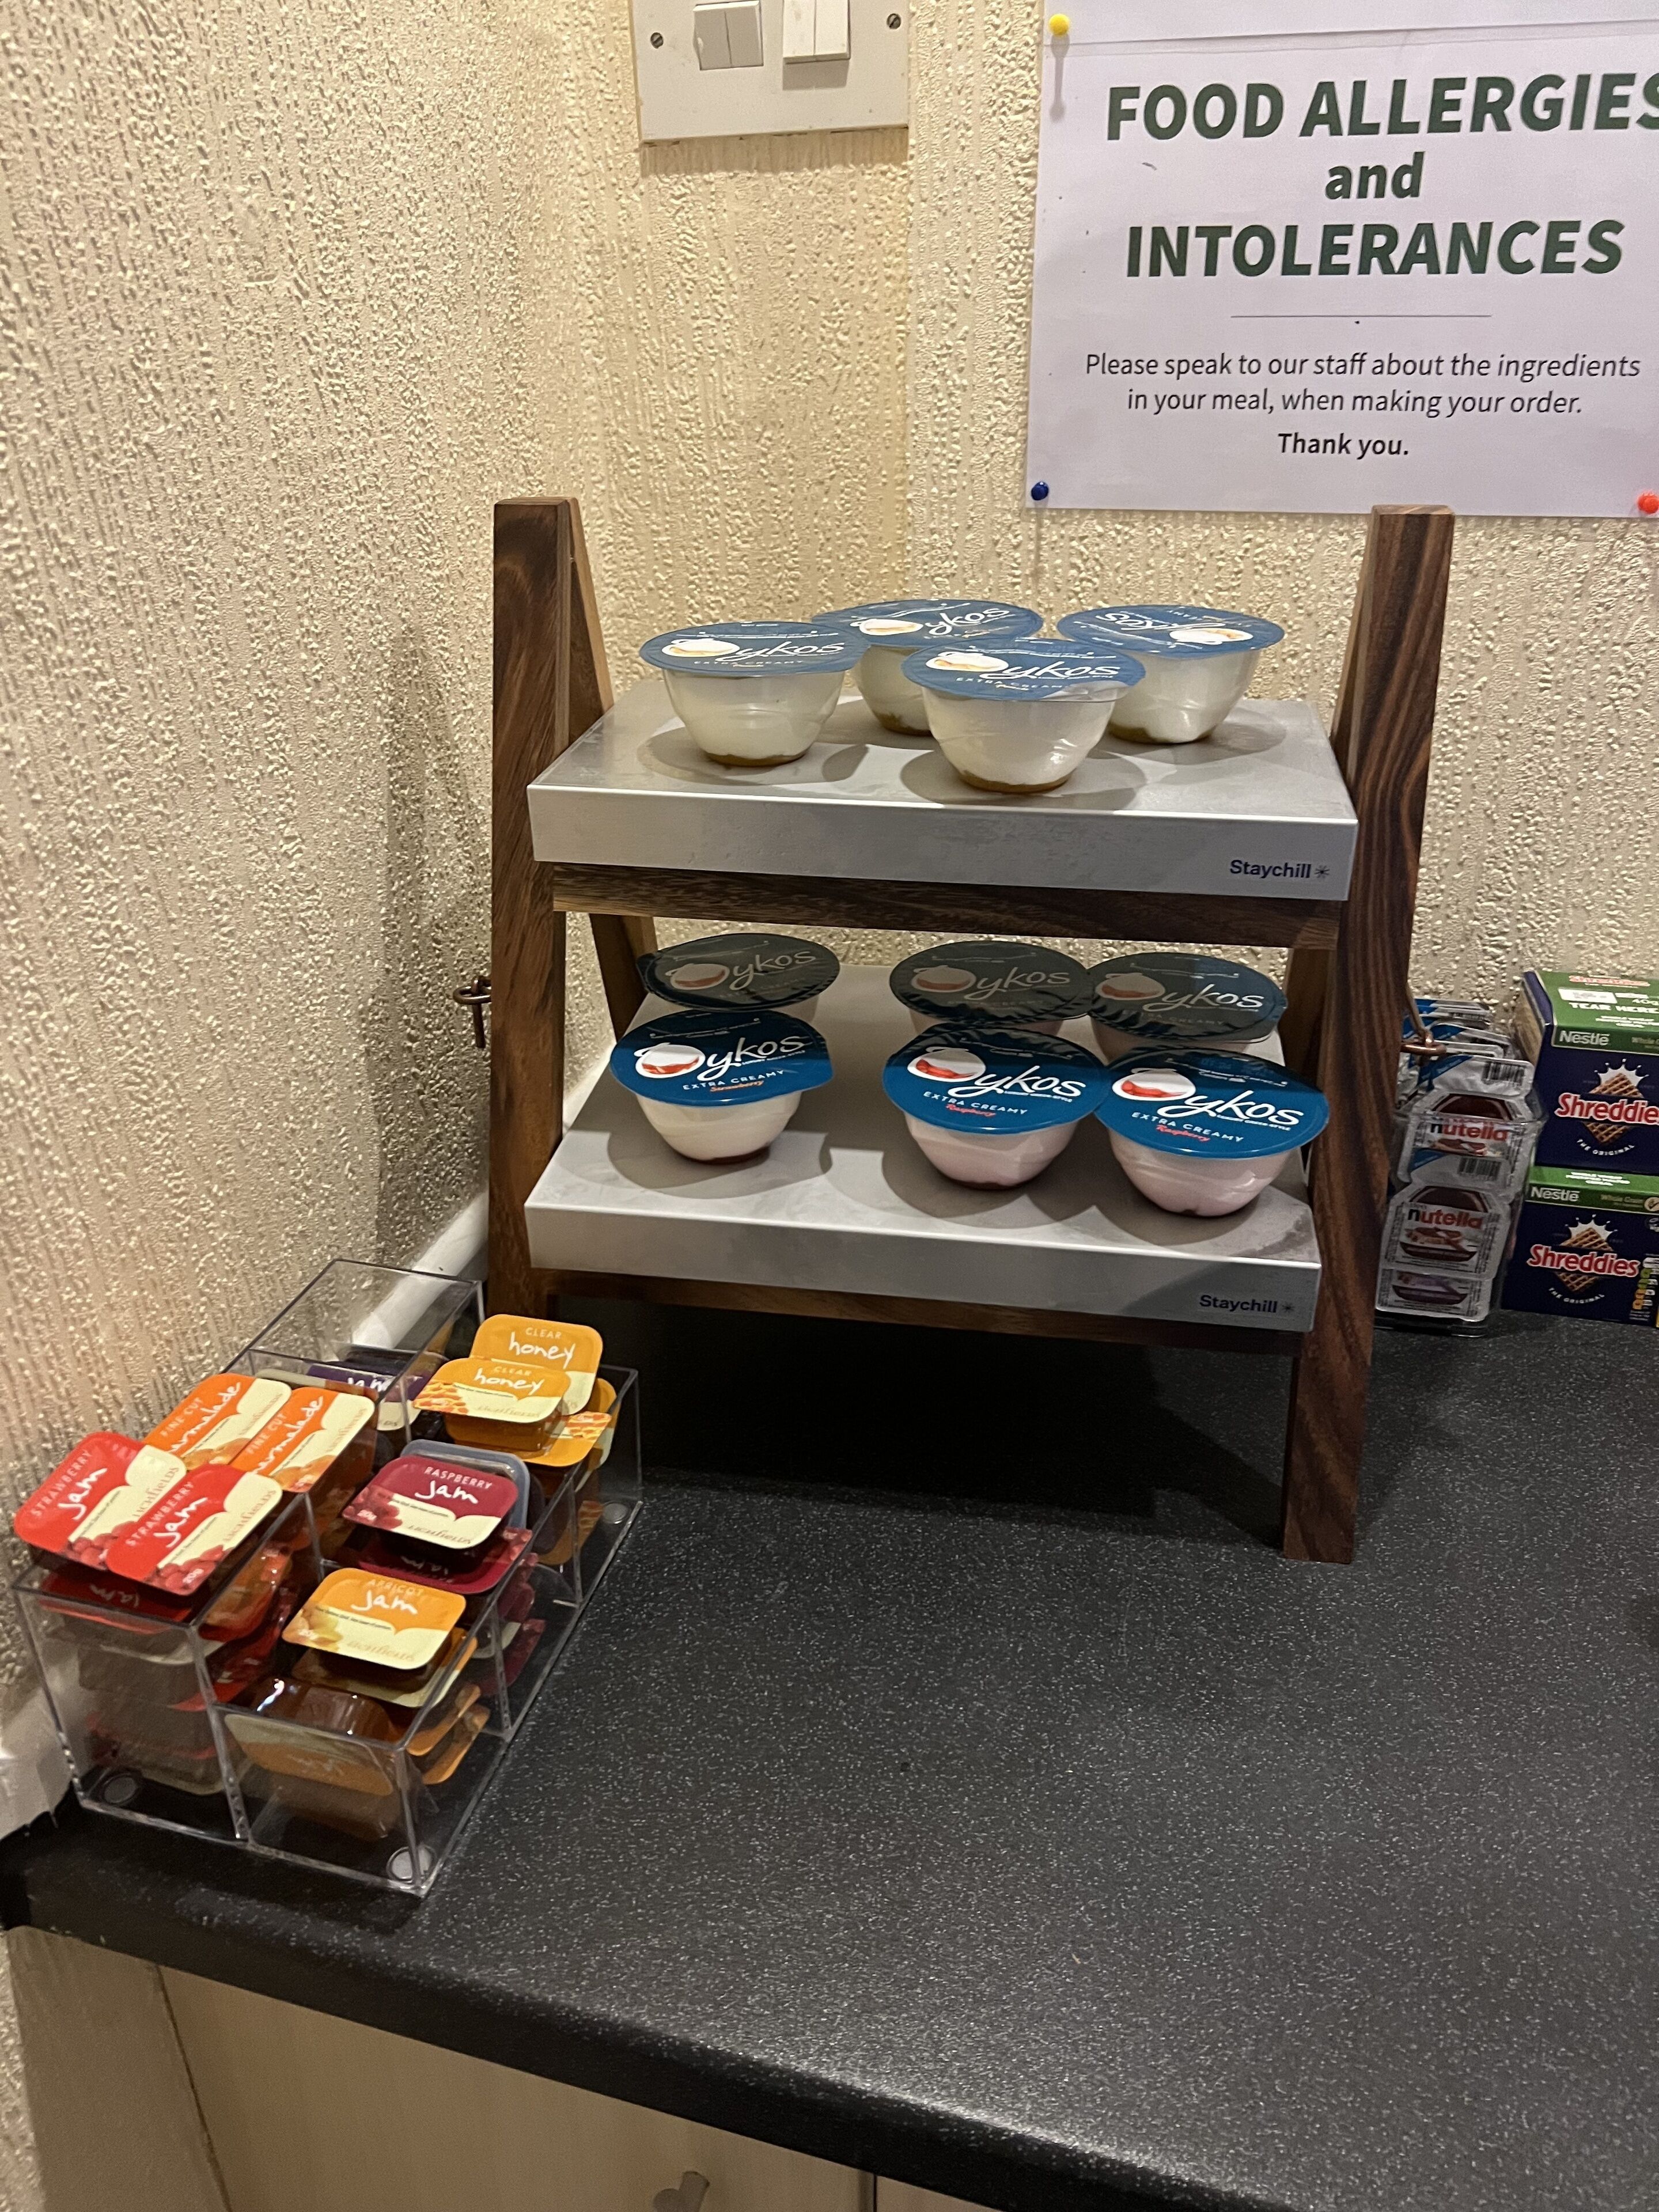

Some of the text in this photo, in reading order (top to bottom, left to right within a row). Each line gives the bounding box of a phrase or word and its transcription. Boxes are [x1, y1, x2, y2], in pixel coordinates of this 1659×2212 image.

[1107, 83, 1284, 141] FOOD
[1325, 151, 1425, 200] and
[1126, 219, 1625, 278] INTOLERANCES
[1086, 351, 1641, 383] Please speak to our staff about the ingredients
[1128, 388, 1582, 418] in your meal, when making your order.
[1278, 432, 1409, 460] Thank you.
[1229, 859, 1312, 879] Staychill
[634, 1036, 808, 1081] Oykos
[907, 1046, 1086, 1098] Oykos
[682, 1069, 785, 1090] EXTRA CREAMY
[923, 1090, 1029, 1115] EXTRA CREAMY
[1112, 1067, 1304, 1126] Oykos
[1554, 1092, 1659, 1126] Shreddie
[1131, 1111, 1177, 1127] EXTRA
[1183, 1123, 1244, 1142] CREAMY
[1430, 1120, 1509, 1142] nutella
[1407, 1208, 1484, 1230] nutella
[1527, 1244, 1641, 1278] Shreddies
[1199, 1294, 1278, 1313] Staychill
[525, 1327, 562, 1340] CLEAR
[508, 1332, 576, 1370] honey
[474, 1368, 546, 1396] honey
[494, 1365, 533, 1377] CLEAR
[160, 1397, 204, 1437] FINE CUT
[245, 1434, 271, 1455] FINE
[267, 1412, 287, 1432] CUT
[30, 1449, 93, 1517] STRAWBERRY
[414, 1480, 479, 1505] Jam
[423, 1466, 493, 1490] RASPBERRY
[58, 1468, 108, 1521] Jam
[124, 1481, 195, 1547] STRAWBERRY
[153, 1497, 209, 1548] Jam
[350, 1589, 419, 1615] Jam
